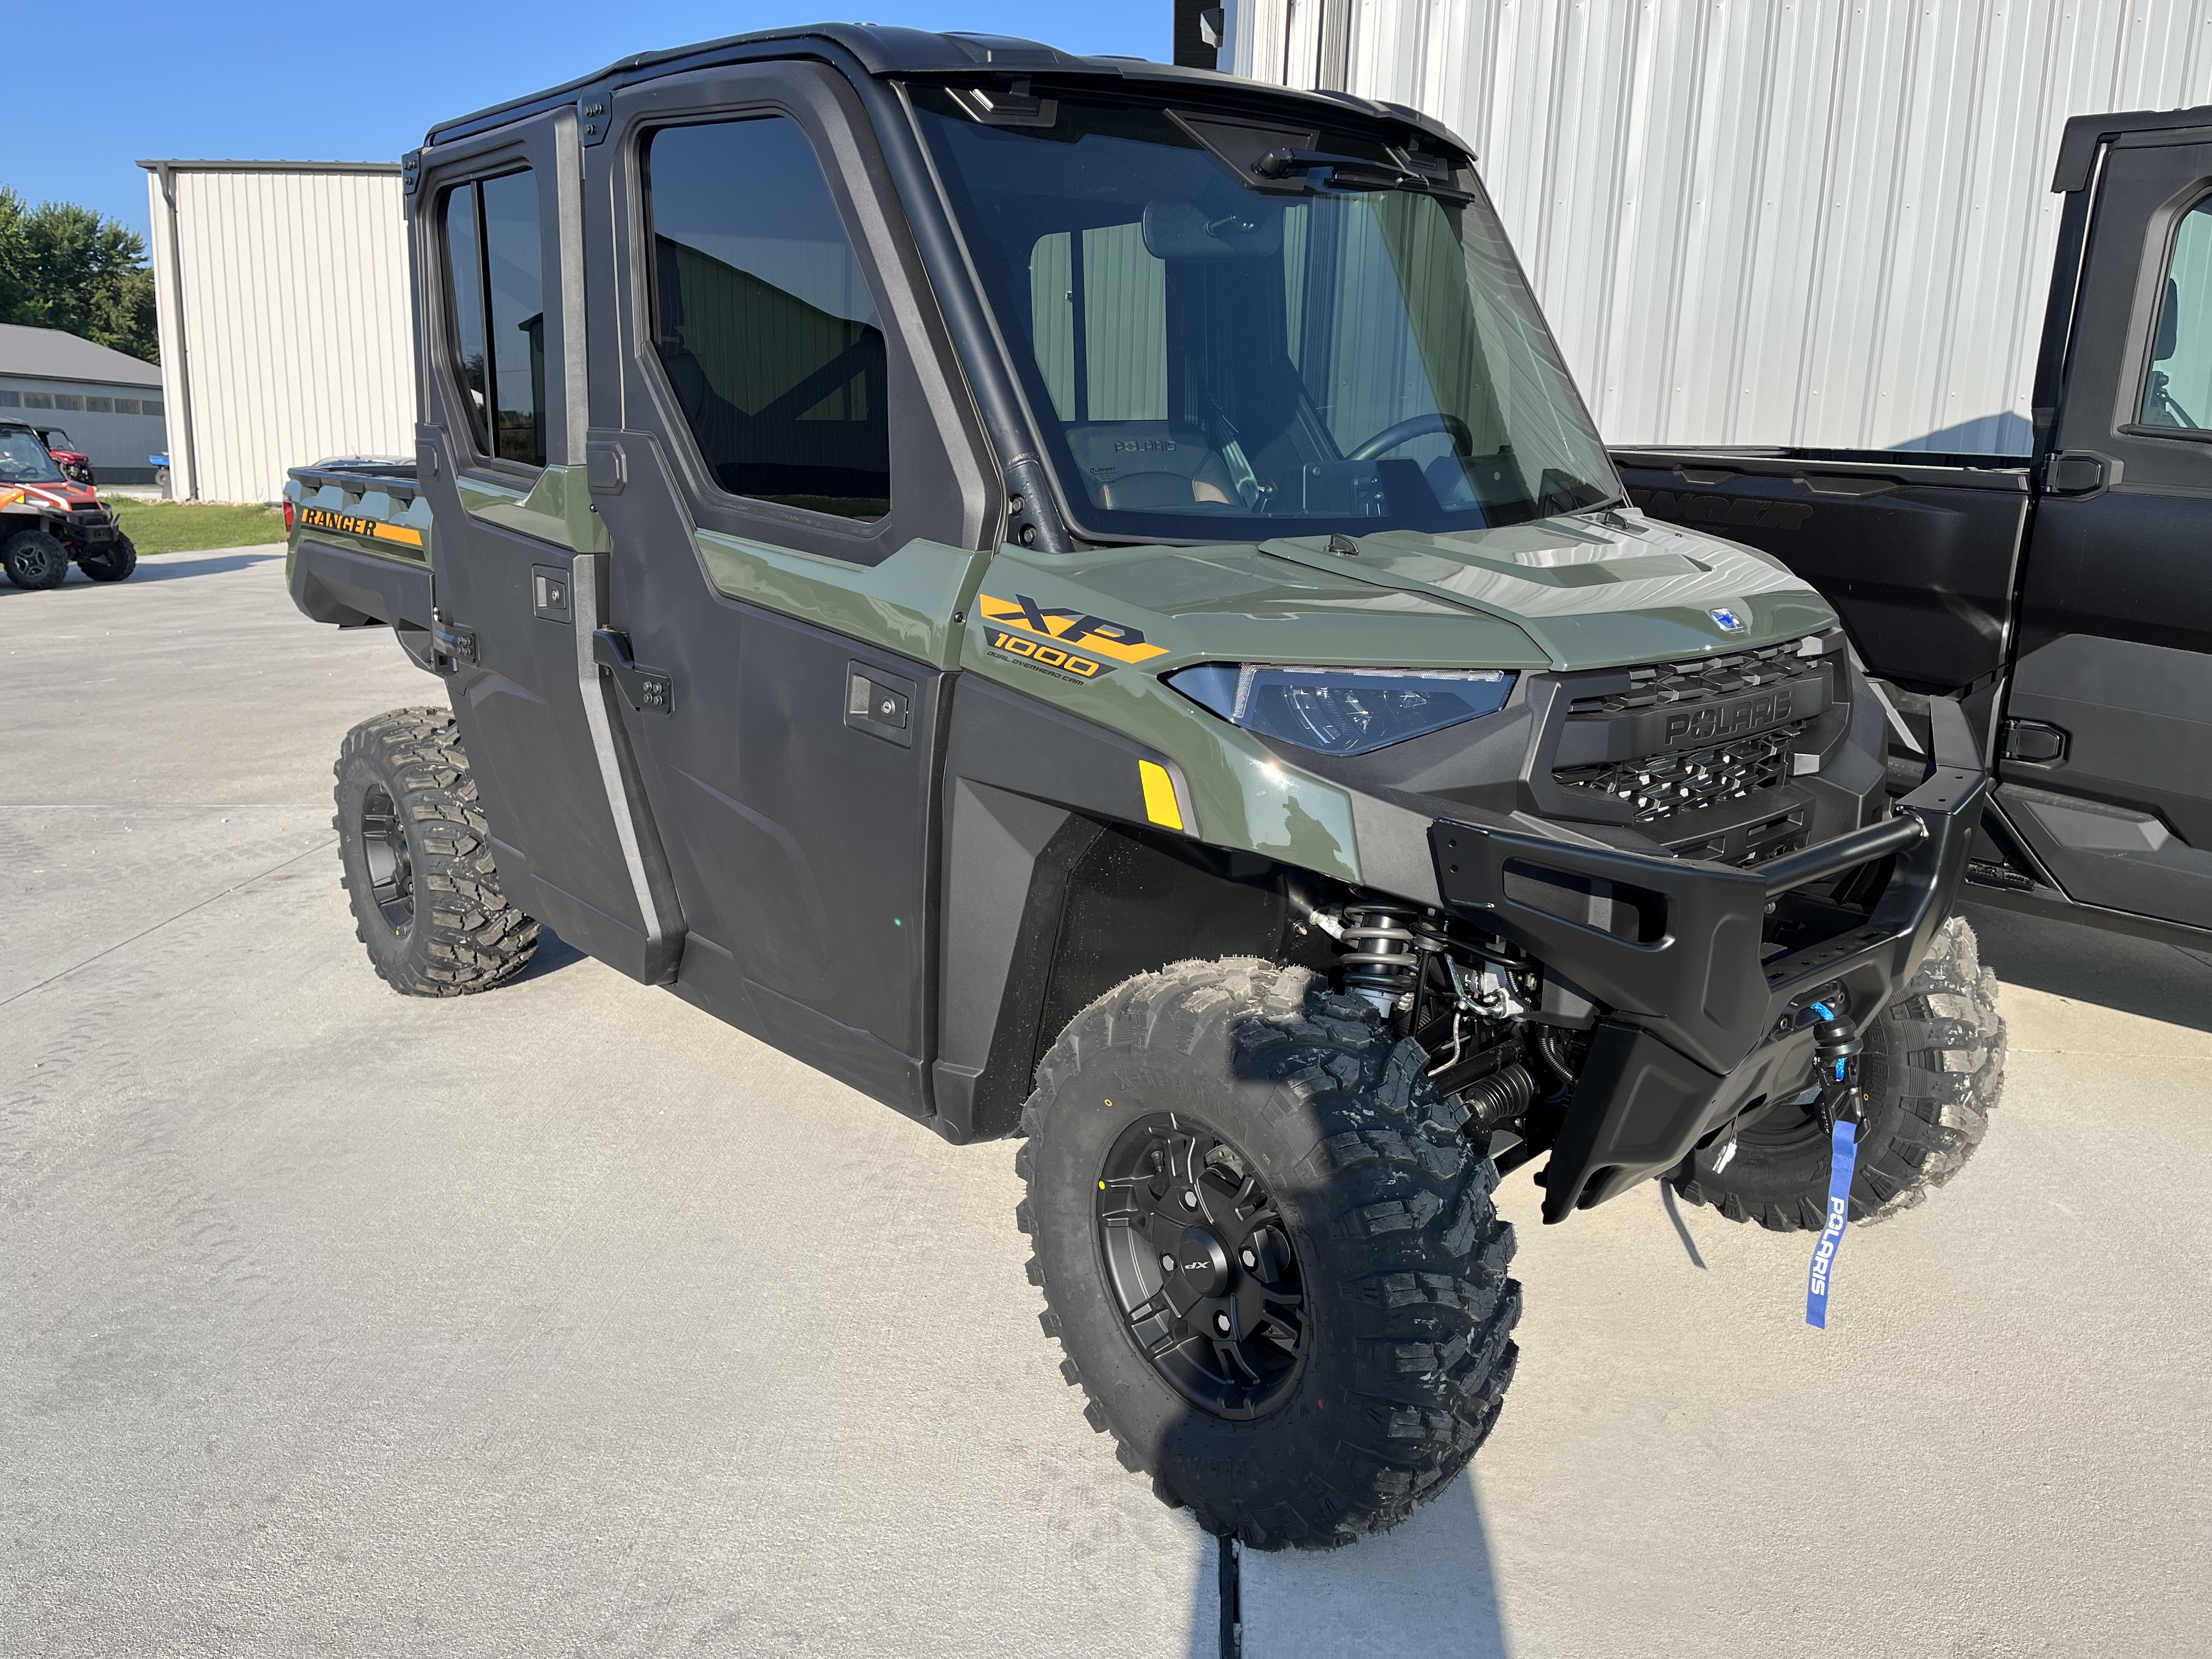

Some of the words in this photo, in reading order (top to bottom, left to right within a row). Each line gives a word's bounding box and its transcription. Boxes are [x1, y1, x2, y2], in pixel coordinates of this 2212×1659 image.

[1115, 441, 1177, 453] POLARIS
[306, 509, 376, 537] RANGER
[988, 593, 1146, 645] XP
[987, 651, 1011, 662] DUAL
[1012, 659, 1062, 679] OVERHEAD
[1062, 675, 1084, 686] CAM
[994, 633, 1100, 677] 1000
[1664, 690, 1792, 746] POLARIS
[1184, 1261, 1211, 1269] XP
[1811, 1197, 1844, 1296] POLARIS
